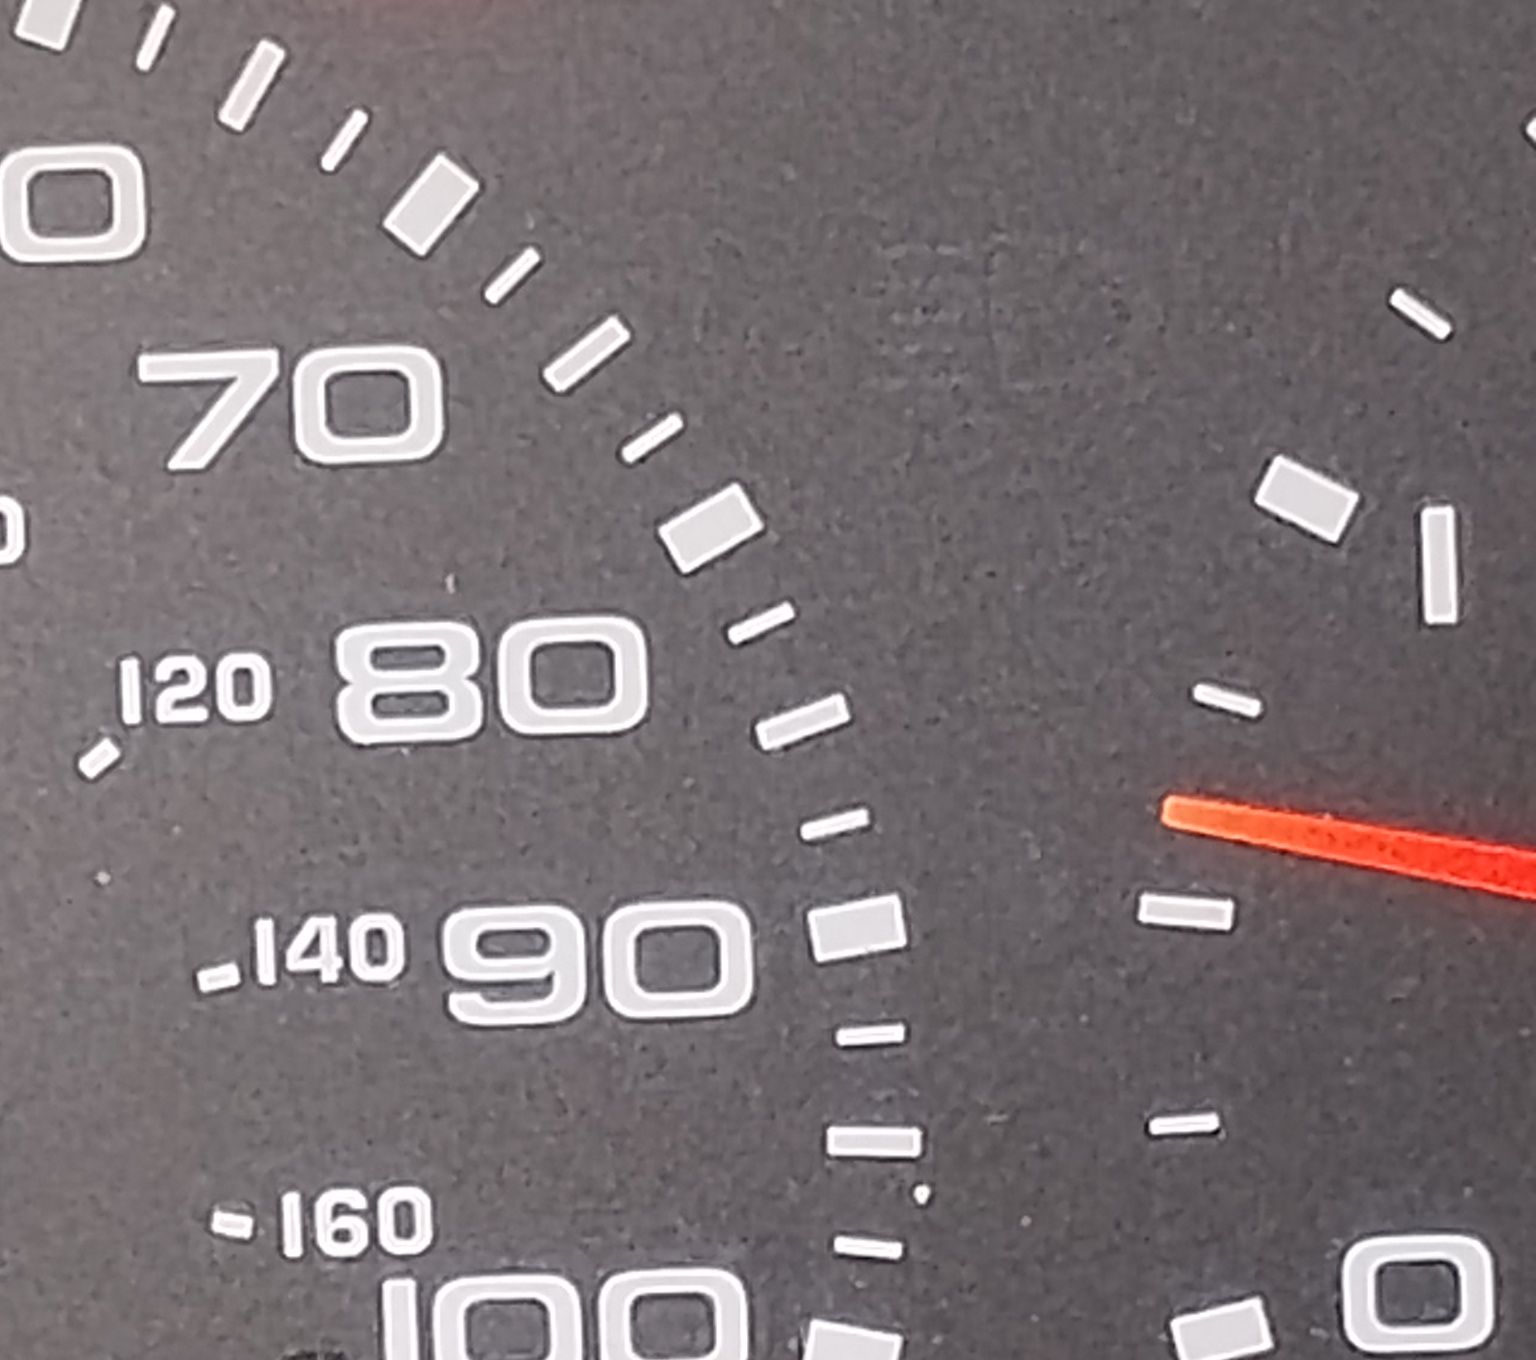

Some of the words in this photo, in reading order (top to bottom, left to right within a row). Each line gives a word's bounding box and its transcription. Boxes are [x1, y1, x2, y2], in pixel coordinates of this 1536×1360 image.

[136, 342, 446, 472] 70
[118, 650, 274, 727] 120
[334, 614, 650, 746] 80
[253, 911, 407, 987] 140
[440, 898, 755, 1027] 90
[280, 1184, 435, 1260] 160
[1339, 1232, 1497, 1355] 0
